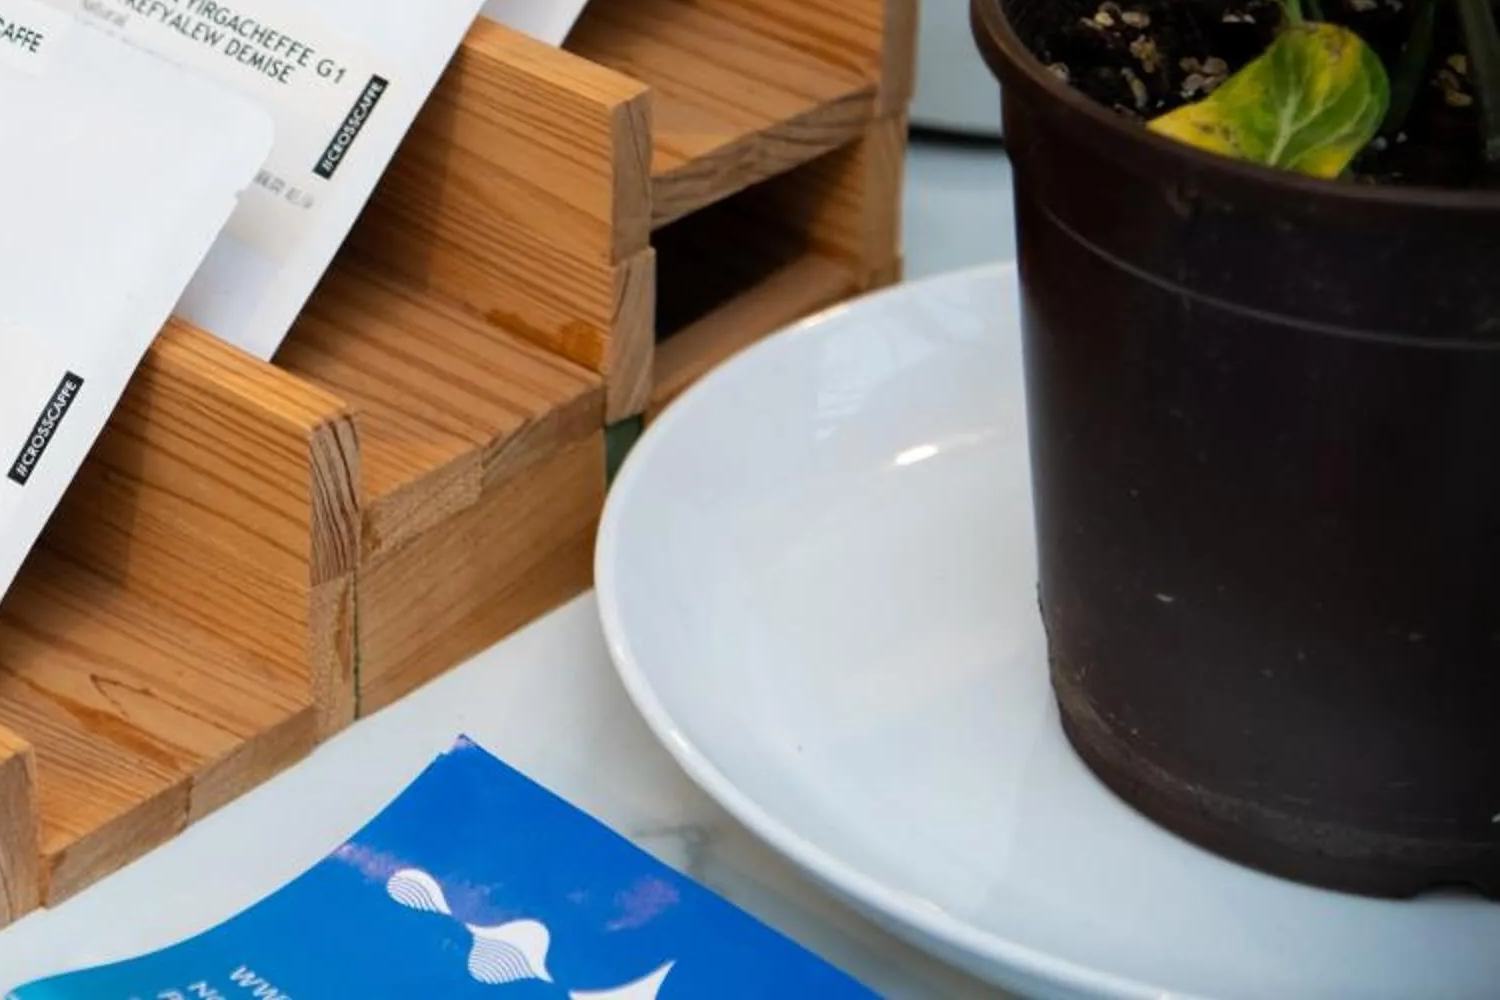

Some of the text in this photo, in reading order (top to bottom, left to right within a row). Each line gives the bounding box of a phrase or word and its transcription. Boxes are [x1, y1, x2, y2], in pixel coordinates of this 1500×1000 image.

[223, 37, 296, 85] DEMISE
[316, 56, 348, 85] G1
[322, 81, 385, 173] #CROSSCAFFE
[16, 379, 77, 477] #CROSSCAFFE
